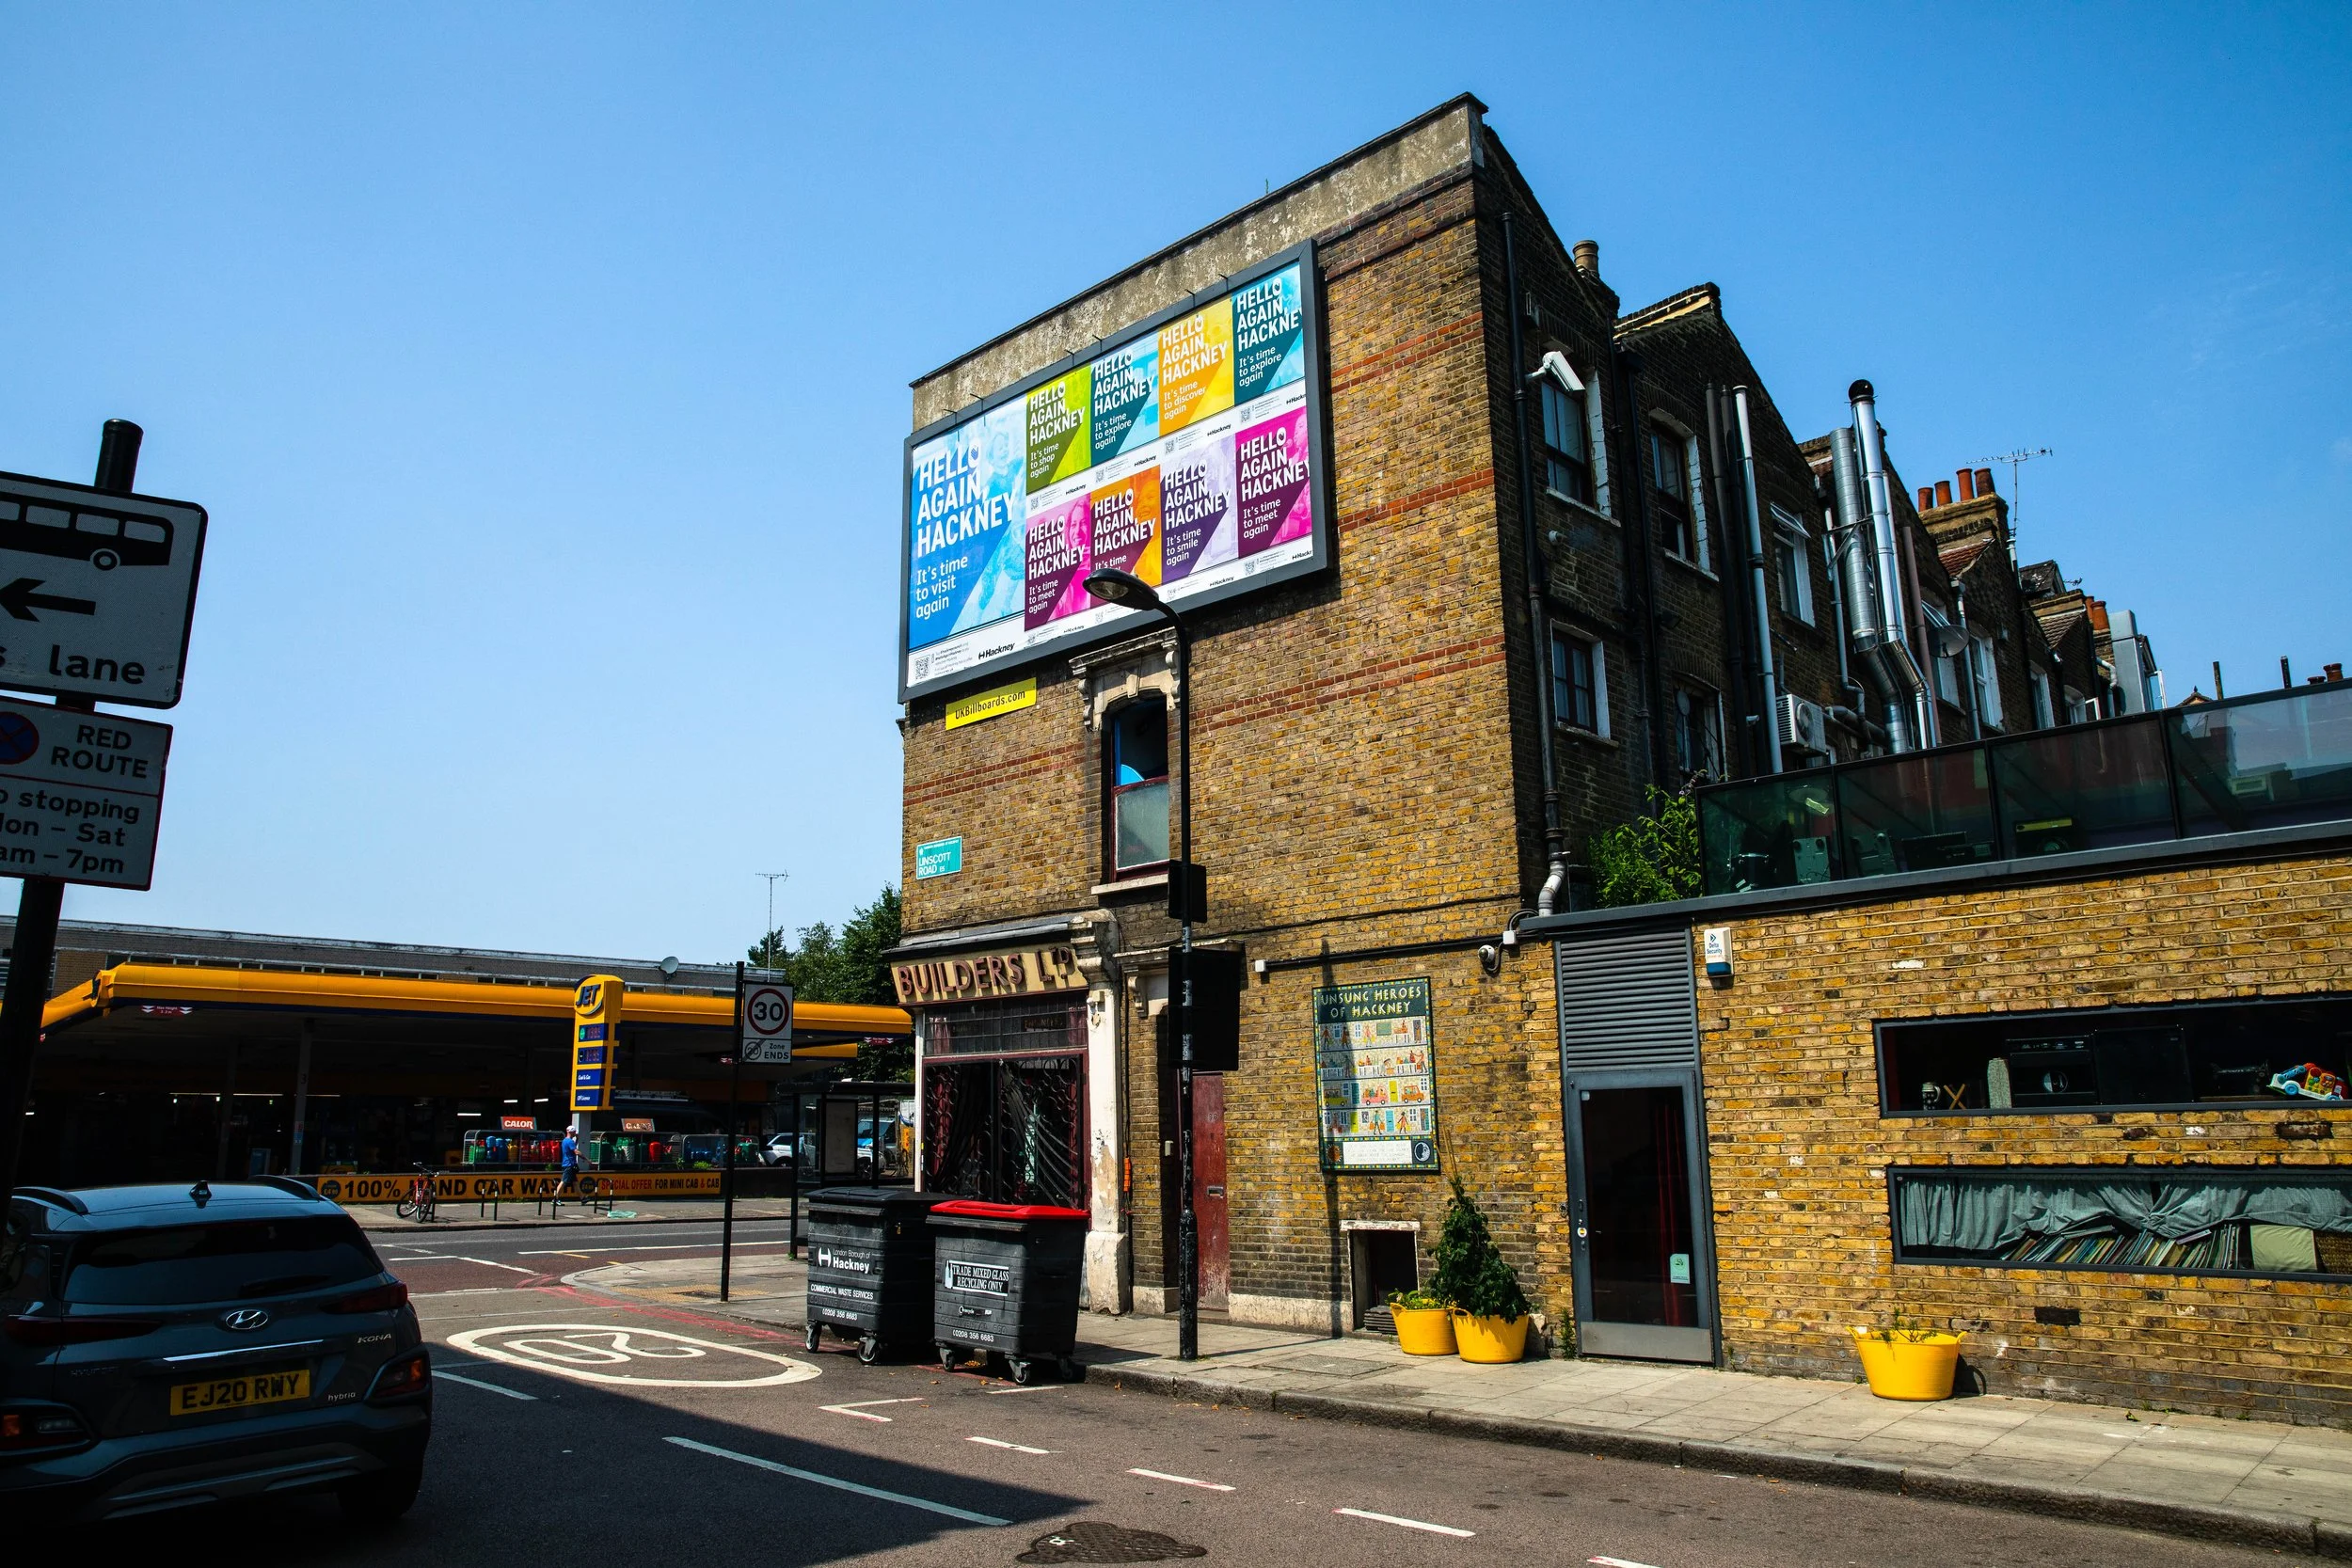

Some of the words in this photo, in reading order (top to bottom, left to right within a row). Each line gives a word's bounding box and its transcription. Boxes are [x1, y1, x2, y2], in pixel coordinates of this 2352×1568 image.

[1236, 277, 1281, 312] HELLO
[1237, 297, 1287, 333] AGAIN,
[1162, 314, 1204, 349] HELLO
[1162, 333, 1208, 367] AGAIN,
[1239, 355, 1253, 368] It's
[1256, 346, 1276, 359] time
[1095, 353, 1132, 381] HELLO
[1163, 341, 1228, 386] HACKNEY
[1239, 367, 1248, 377] to
[1250, 354, 1281, 372] explore
[1094, 366, 1136, 399] AGAIN,
[1240, 371, 1263, 387] again
[1030, 381, 1066, 412] HELLO
[1094, 375, 1153, 417] HACKNEY
[1164, 387, 1178, 401] It's
[1180, 380, 1198, 394] time
[1164, 401, 1172, 411] to
[1174, 387, 1206, 405] discover
[1030, 398, 1070, 429] AGAIN,
[1095, 419, 1107, 432] It's
[1110, 413, 1127, 425] time
[1164, 404, 1186, 420] again
[1030, 406, 1086, 446] HACKNEY
[1095, 432, 1103, 440] to
[1104, 420, 1132, 436] explore
[1212, 424, 1232, 436] Hackney
[1031, 447, 1042, 460] It's
[1044, 443, 1059, 454] time
[1095, 436, 1116, 450] again
[1240, 427, 1287, 462] HELLO
[919, 439, 980, 491] HELLO
[1030, 464, 1049, 479] again
[1031, 461, 1038, 469] to
[1040, 453, 1055, 466] shop
[1241, 447, 1292, 482] AGAIN,
[1165, 459, 1207, 491] HELLO
[1242, 461, 1310, 502] HACKNEY
[917, 470, 990, 525] AGAIN,
[1095, 488, 1134, 518] HELLO
[1165, 480, 1212, 511] AGAIN,
[1166, 489, 1232, 531] HACKNEY
[1244, 505, 1259, 519] It's
[1261, 499, 1280, 512] time
[1244, 518, 1252, 529] to
[1255, 510, 1278, 525] meet
[917, 488, 1015, 558] HACKNEY
[1029, 515, 1065, 544] HELLO
[1094, 506, 1138, 537] AGAIN,
[1244, 522, 1268, 539] again
[1028, 533, 1069, 562] AGAIN,
[1094, 518, 1156, 556] HACKNEY
[1167, 533, 1181, 546] It's
[1183, 528, 1201, 541] time
[1167, 546, 1175, 556] to
[1177, 538, 1198, 553] smile
[940, 557, 968, 575] time
[1028, 545, 1086, 580] HACKNEY
[1109, 555, 1127, 566] time
[1167, 551, 1189, 566] again
[916, 587, 929, 602] to
[931, 575, 956, 594] visit
[1029, 583, 1041, 595] It's
[1043, 579, 1058, 592] time
[1029, 595, 1037, 605] to
[1039, 589, 1055, 602] meet
[915, 596, 949, 620] again
[1029, 601, 1048, 614] again
[985, 642, 1015, 658] Hackney
[49, 644, 145, 684] lane
[955, 690, 1025, 720] UKBillboards.com
[77, 724, 132, 750] RED
[51, 746, 149, 779] ROUTE
[18, 790, 139, 825] stopping
[76, 823, 125, 846] Sat
[67, 848, 123, 874] 7pm
[918, 851, 952, 866] LINSCOTT
[918, 864, 938, 877] ROAD
[898, 954, 1025, 996] BUILDERS
[576, 984, 601, 1006] JET
[1375, 987, 1422, 1001] HEROES
[754, 1001, 783, 1022] 30
[1331, 1006, 1345, 1019] OF
[1352, 1001, 1410, 1017] HACKNEY
[764, 1052, 789, 1060] ENDS
[504, 1119, 533, 1129] CALOR
[345, 1180, 401, 1198] 100%
[474, 1178, 514, 1195] CAR
[601, 1180, 628, 1190] SPCIAL
[631, 1180, 652, 1189] OFFER
[655, 1179, 667, 1189] FOR
[670, 1179, 684, 1188] MINI
[686, 1179, 698, 1188] CAB
[700, 1179, 705, 1188] &
[707, 1179, 719, 1188] CAB
[834, 1257, 869, 1274] Hackney
[849, 1250, 865, 1259] Borough
[952, 1265, 972, 1275] TRADE
[973, 1268, 991, 1278] MIXED
[993, 1270, 1009, 1281] GLASS
[958, 1276, 987, 1290] RECYCLING
[988, 1281, 1003, 1291] ONLY
[811, 1284, 836, 1294] COMMERCIAL
[838, 1288, 851, 1296] WASTE
[853, 1290, 873, 1300] SERVICES
[358, 1333, 392, 1344] KONA
[182, 1381, 247, 1409] EJ20
[254, 1373, 300, 1400] RWY
